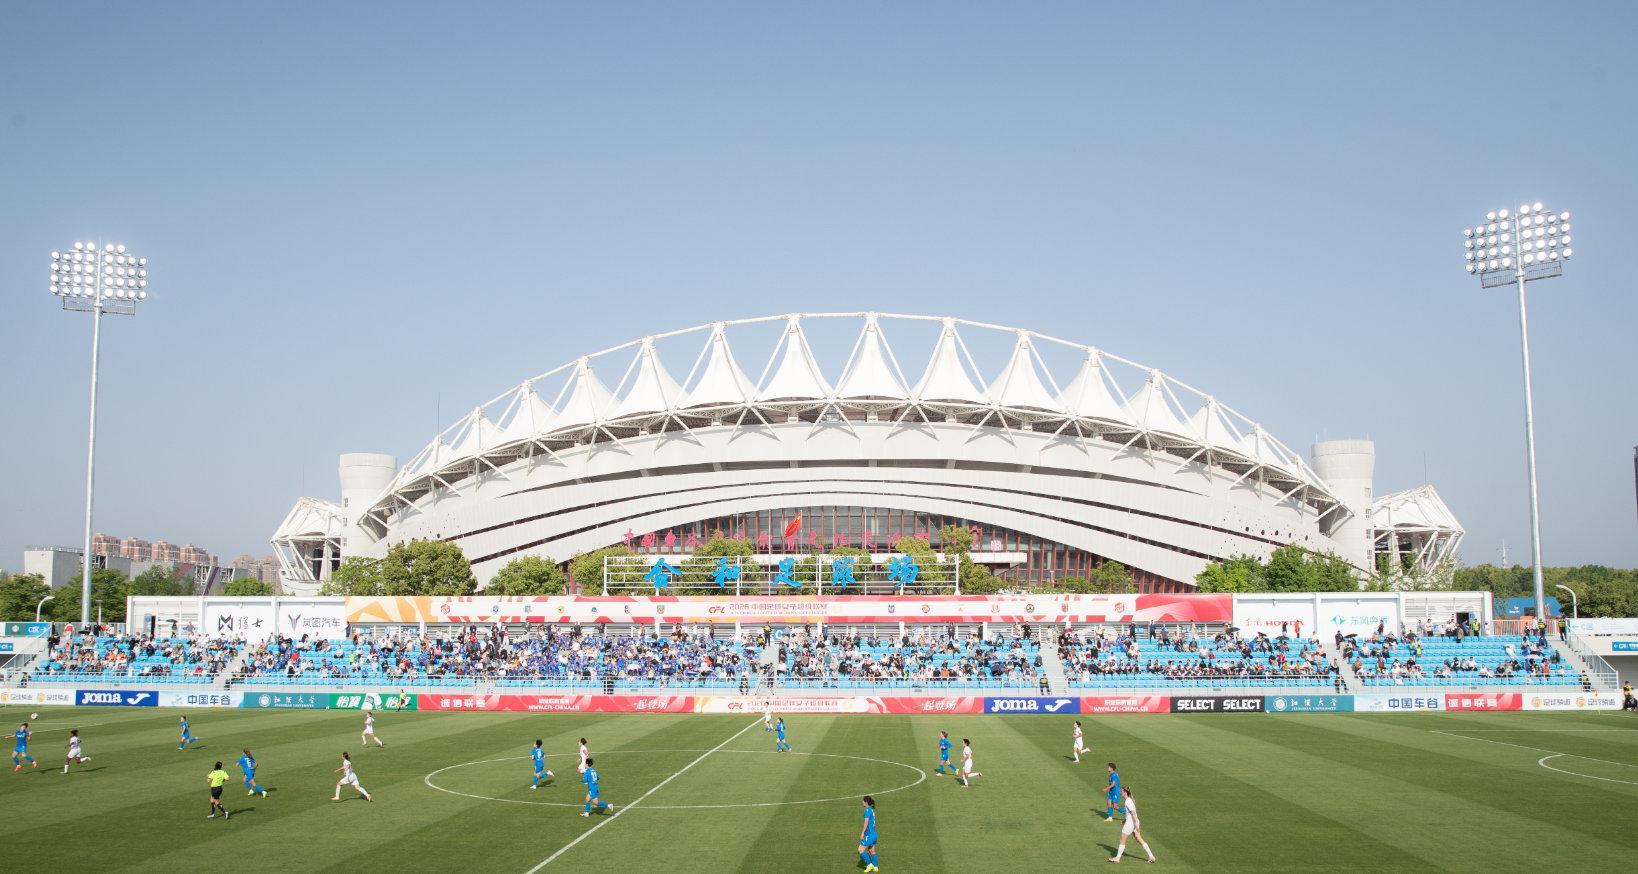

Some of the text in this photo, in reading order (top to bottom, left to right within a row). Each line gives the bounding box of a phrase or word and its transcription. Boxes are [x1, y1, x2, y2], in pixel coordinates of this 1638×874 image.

[302, 617, 341, 628] 岚图汽车
[187, 694, 231, 705] 中国车谷
[1177, 699, 1261, 710] SELECT SELECT
[1389, 698, 1438, 709] 中国车谷
[1447, 698, 1498, 708] 诚信联赛
